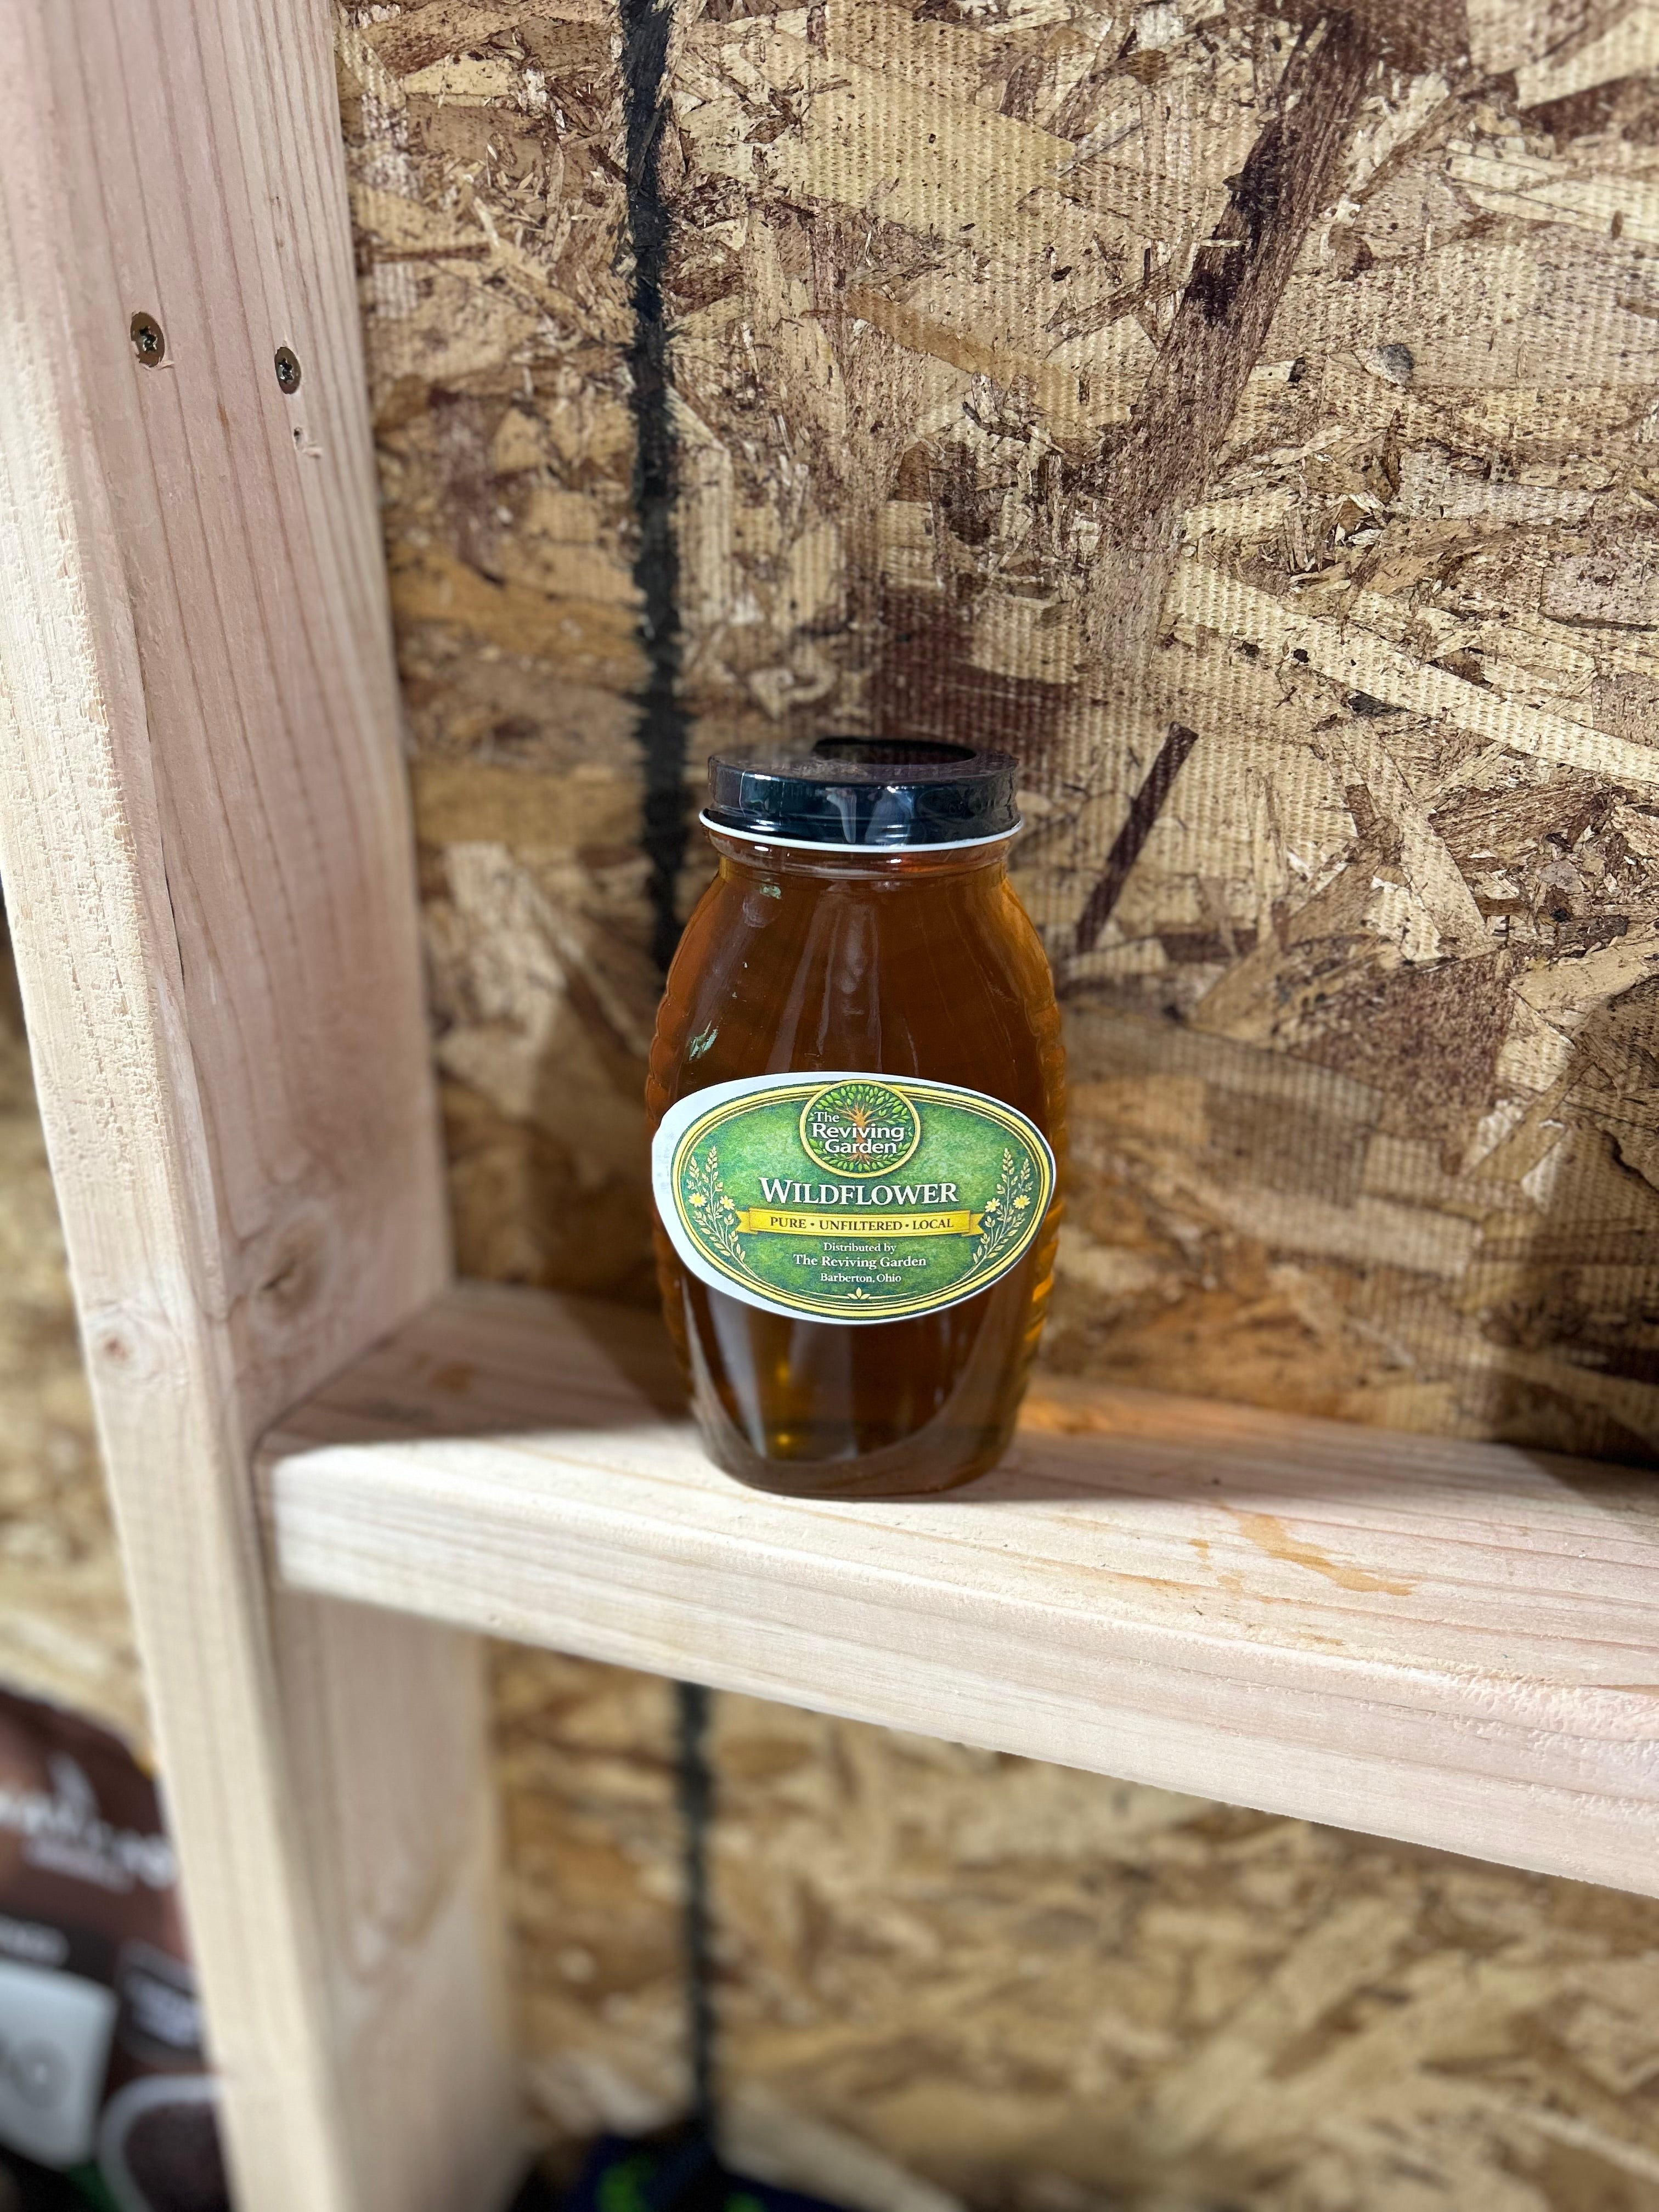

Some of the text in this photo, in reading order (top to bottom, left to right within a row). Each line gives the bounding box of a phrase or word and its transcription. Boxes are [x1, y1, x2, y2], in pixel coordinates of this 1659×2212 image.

[814, 1111, 840, 1122] The
[812, 1122, 905, 1142] Reviving
[825, 1138, 898, 1154] Garden
[759, 1177, 960, 1206] WILDFLOWER
[769, 1216, 955, 1231] PURE UNFILTERED LOCAL
[823, 1242, 897, 1255] Distributed by
[793, 1254, 927, 1270] The Reviving Garden
[876, 1273, 902, 1283] Ohio
